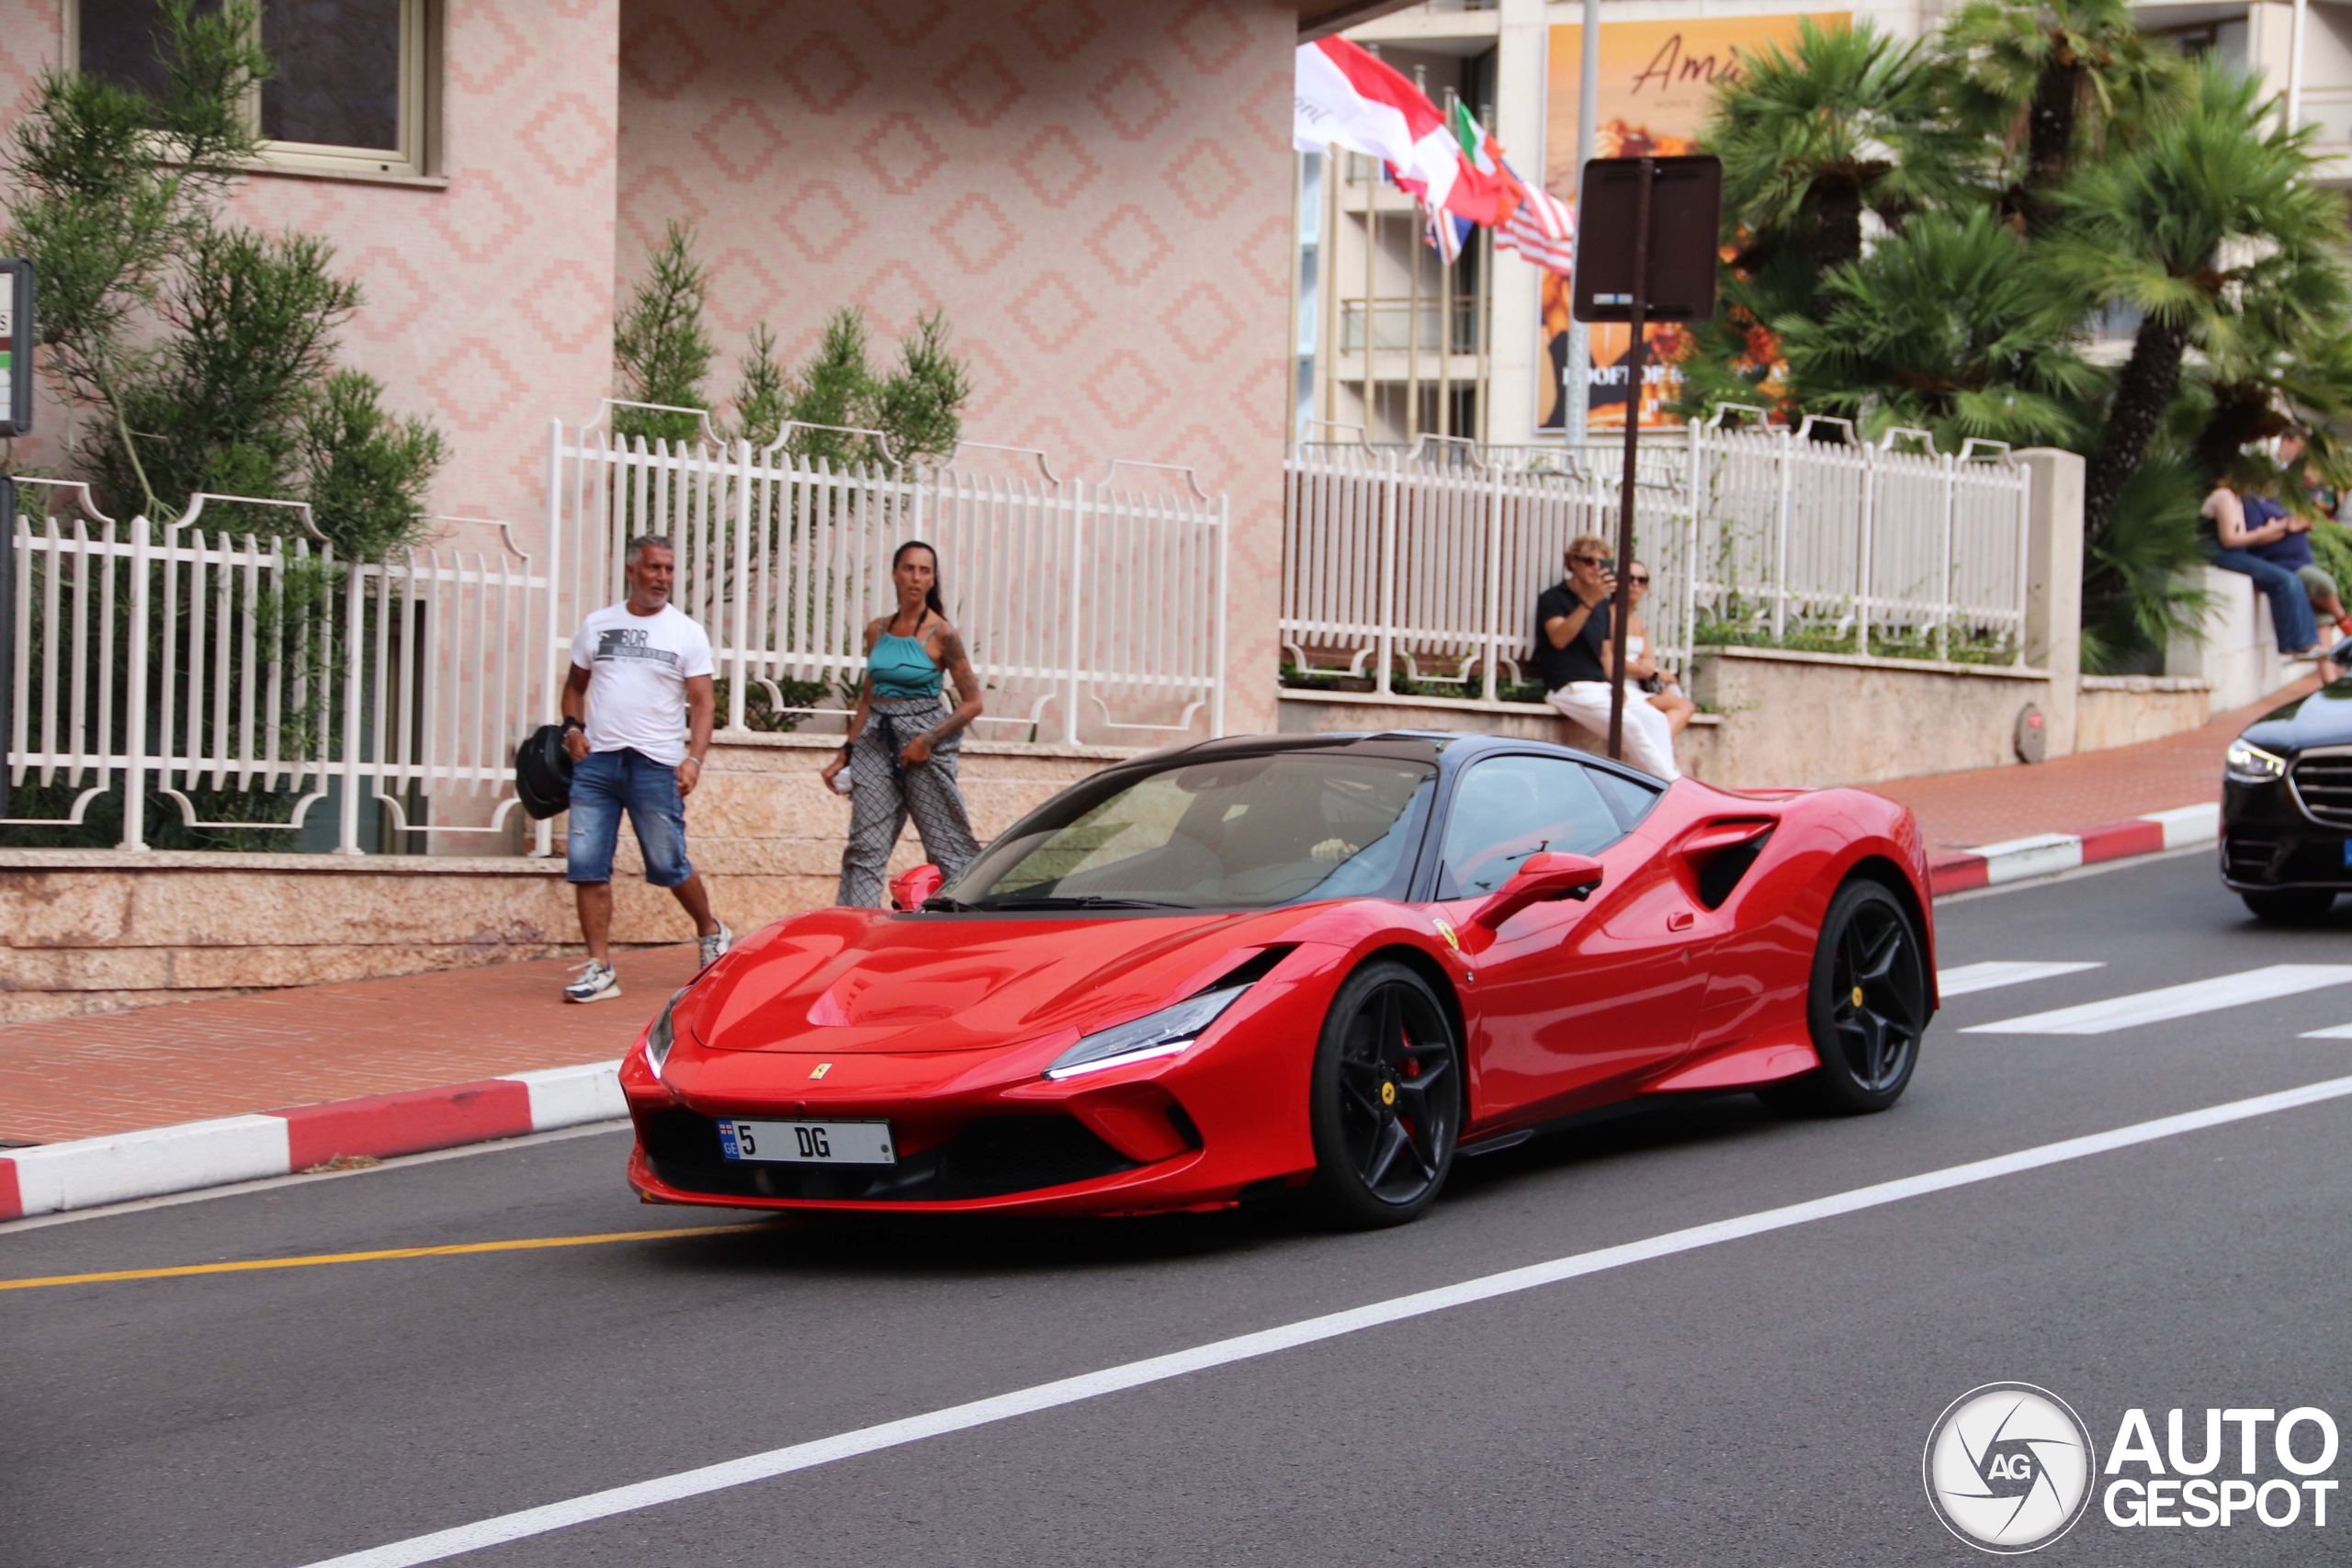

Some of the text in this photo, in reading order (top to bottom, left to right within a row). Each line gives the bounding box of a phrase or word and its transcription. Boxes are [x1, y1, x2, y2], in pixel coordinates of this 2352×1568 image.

[724, 1142, 738, 1155] GE
[738, 1125, 831, 1157] 5 DG
